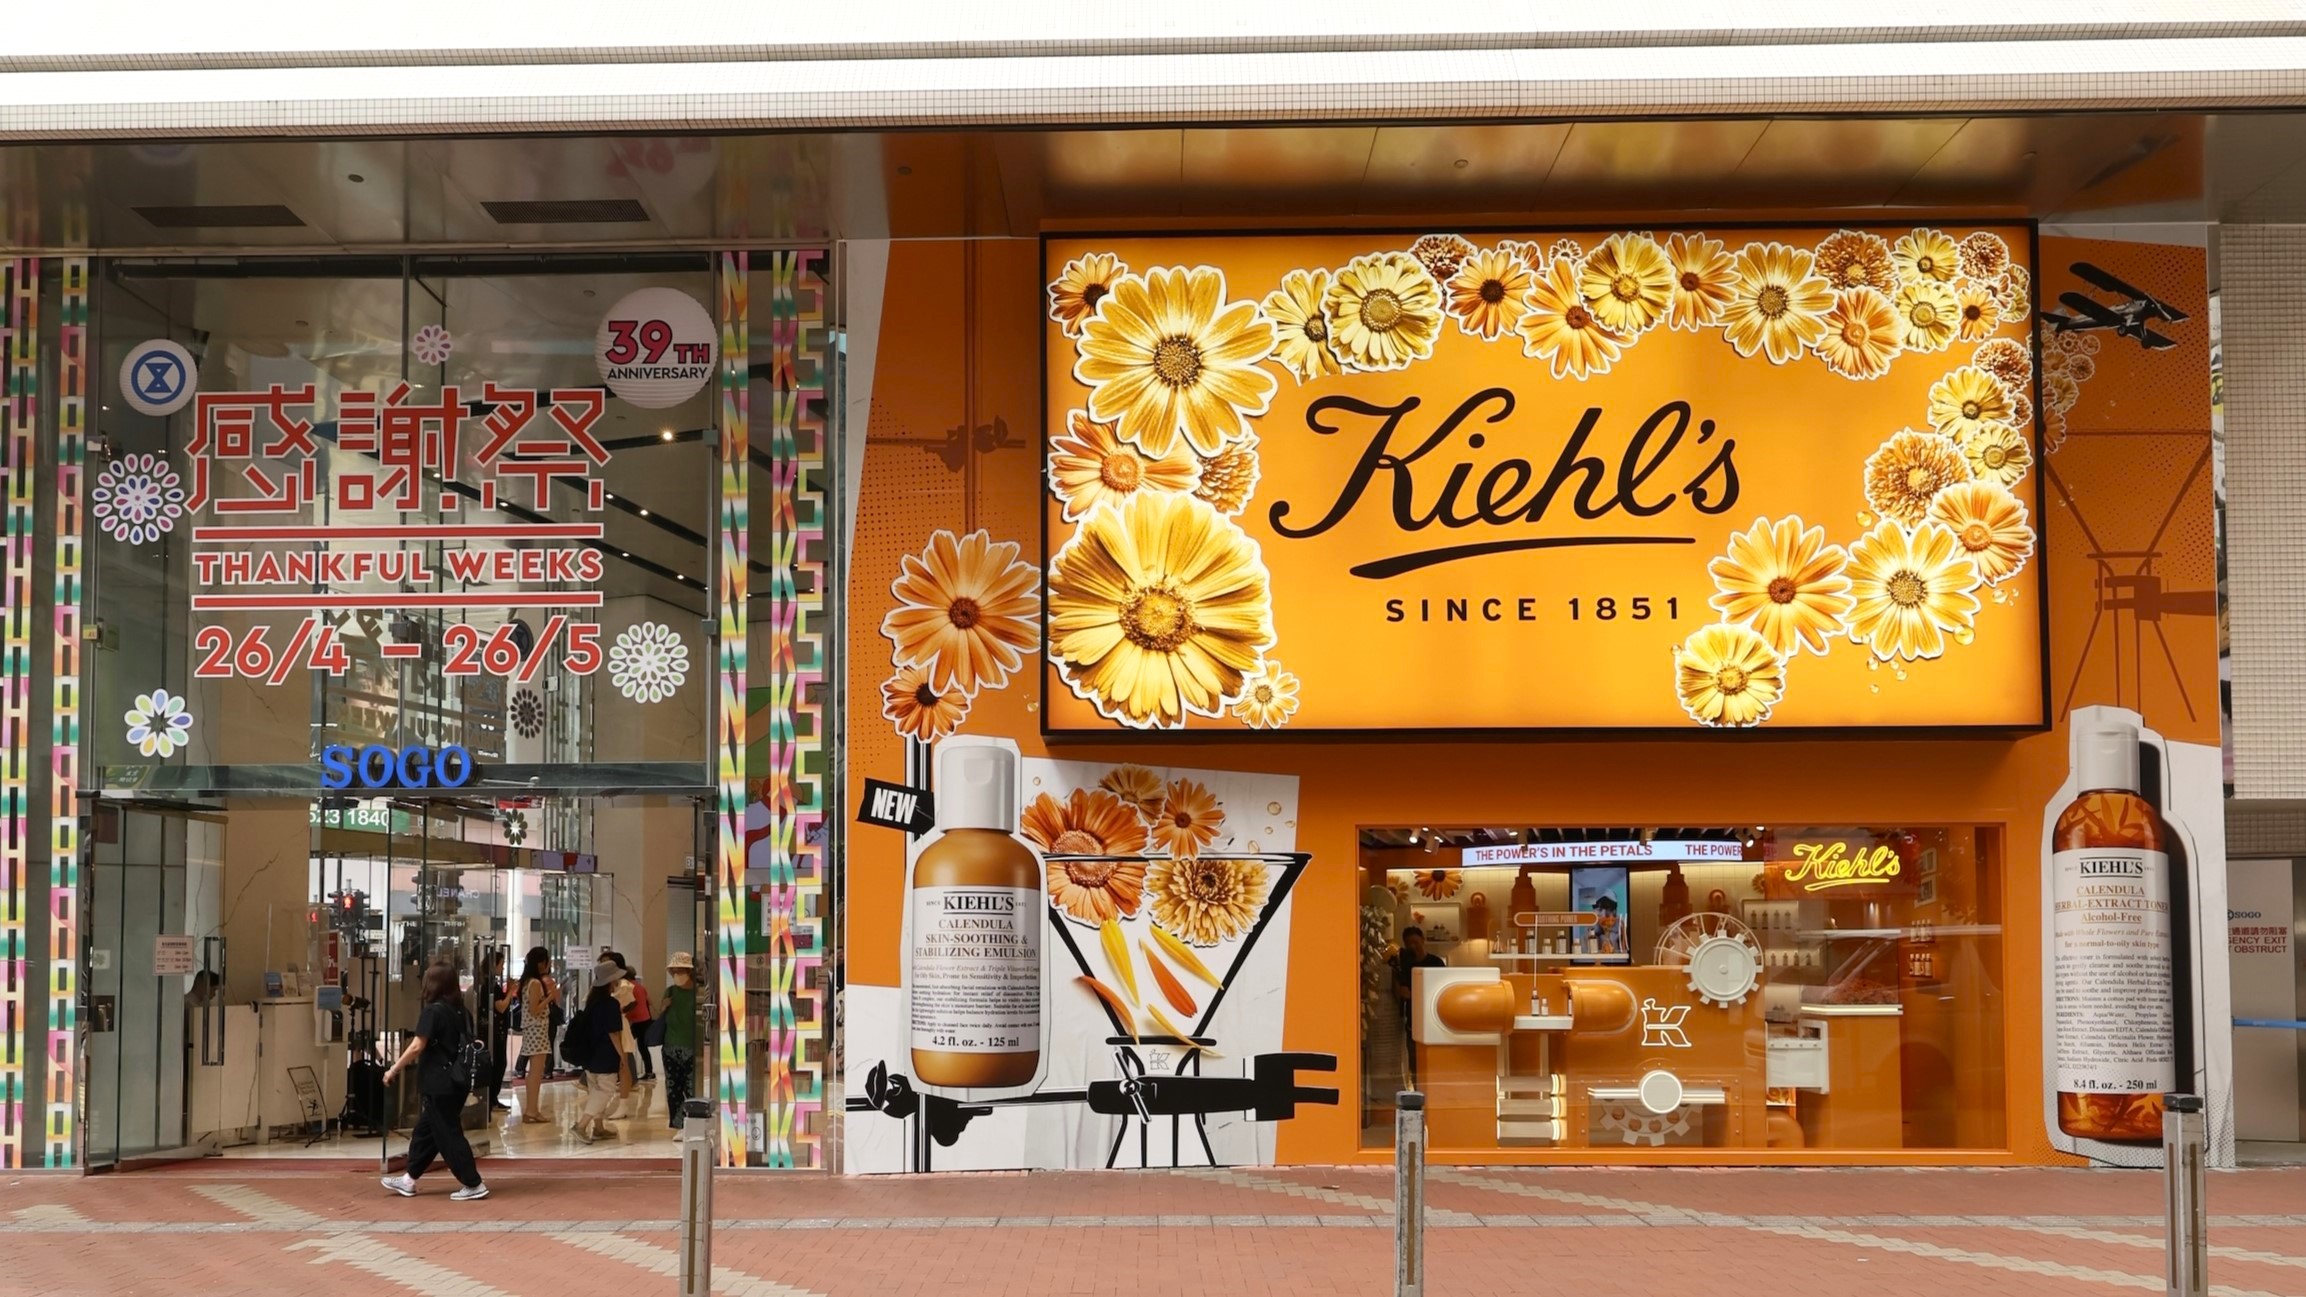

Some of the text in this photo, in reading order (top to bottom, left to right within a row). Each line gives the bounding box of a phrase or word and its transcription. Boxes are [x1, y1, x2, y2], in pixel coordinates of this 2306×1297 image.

[605, 320, 710, 365] 39TH
[607, 367, 708, 379] ANNIVERSARY
[184, 381, 611, 514] 感謝祭
[1269, 386, 1740, 538] Kiehl's
[193, 547, 604, 586] THANKFUL WEEKS
[1385, 596, 1681, 623] SINCE 1851
[194, 618, 351, 686] 26/4
[442, 614, 604, 684] 26/5
[320, 744, 472, 789] SOGO
[870, 787, 918, 825] NEW
[1476, 849, 1494, 861] THE
[1496, 847, 1548, 860] POWER'S
[1552, 846, 1565, 858] IN
[1569, 846, 1596, 857] THE
[1600, 844, 1653, 857] PETALS
[1685, 844, 1708, 856] THE
[1785, 842, 1900, 881] Kiehl's
[2080, 861, 2143, 874] KIEHL'S
[2076, 885, 2145, 895] CALENDULA
[943, 896, 1014, 911] KIEHL'S
[2081, 912, 2142, 921] Alcohol-Free
[2234, 911, 2262, 919] SOGO
[938, 919, 1013, 929] CALENDULA
[2097, 928, 2124, 936] Flowers
[2126, 928, 2138, 936] and
[925, 934, 1028, 945] SKIN-SOOTHING &
[2264, 936, 2287, 944] EXIT
[915, 947, 1037, 958] STABILIZING EMULSION
[2234, 945, 2287, 953] OBSTRUCT
[988, 965, 1005, 973] Triple
[969, 973, 1001, 981] Sensitivity
[932, 1036, 945, 1045] 4.2
[948, 1036, 959, 1046] fl.
[962, 1039, 977, 1047] oz.
[988, 1036, 1005, 1047] 125
[1008, 1036, 1019, 1047] ml
[2073, 1080, 2086, 1088] 8.4
[2088, 1080, 2099, 1089] fl.
[2101, 1082, 2117, 1090] oz.
[2126, 1080, 2144, 1090] 250
[2146, 1080, 2157, 1090] ml
